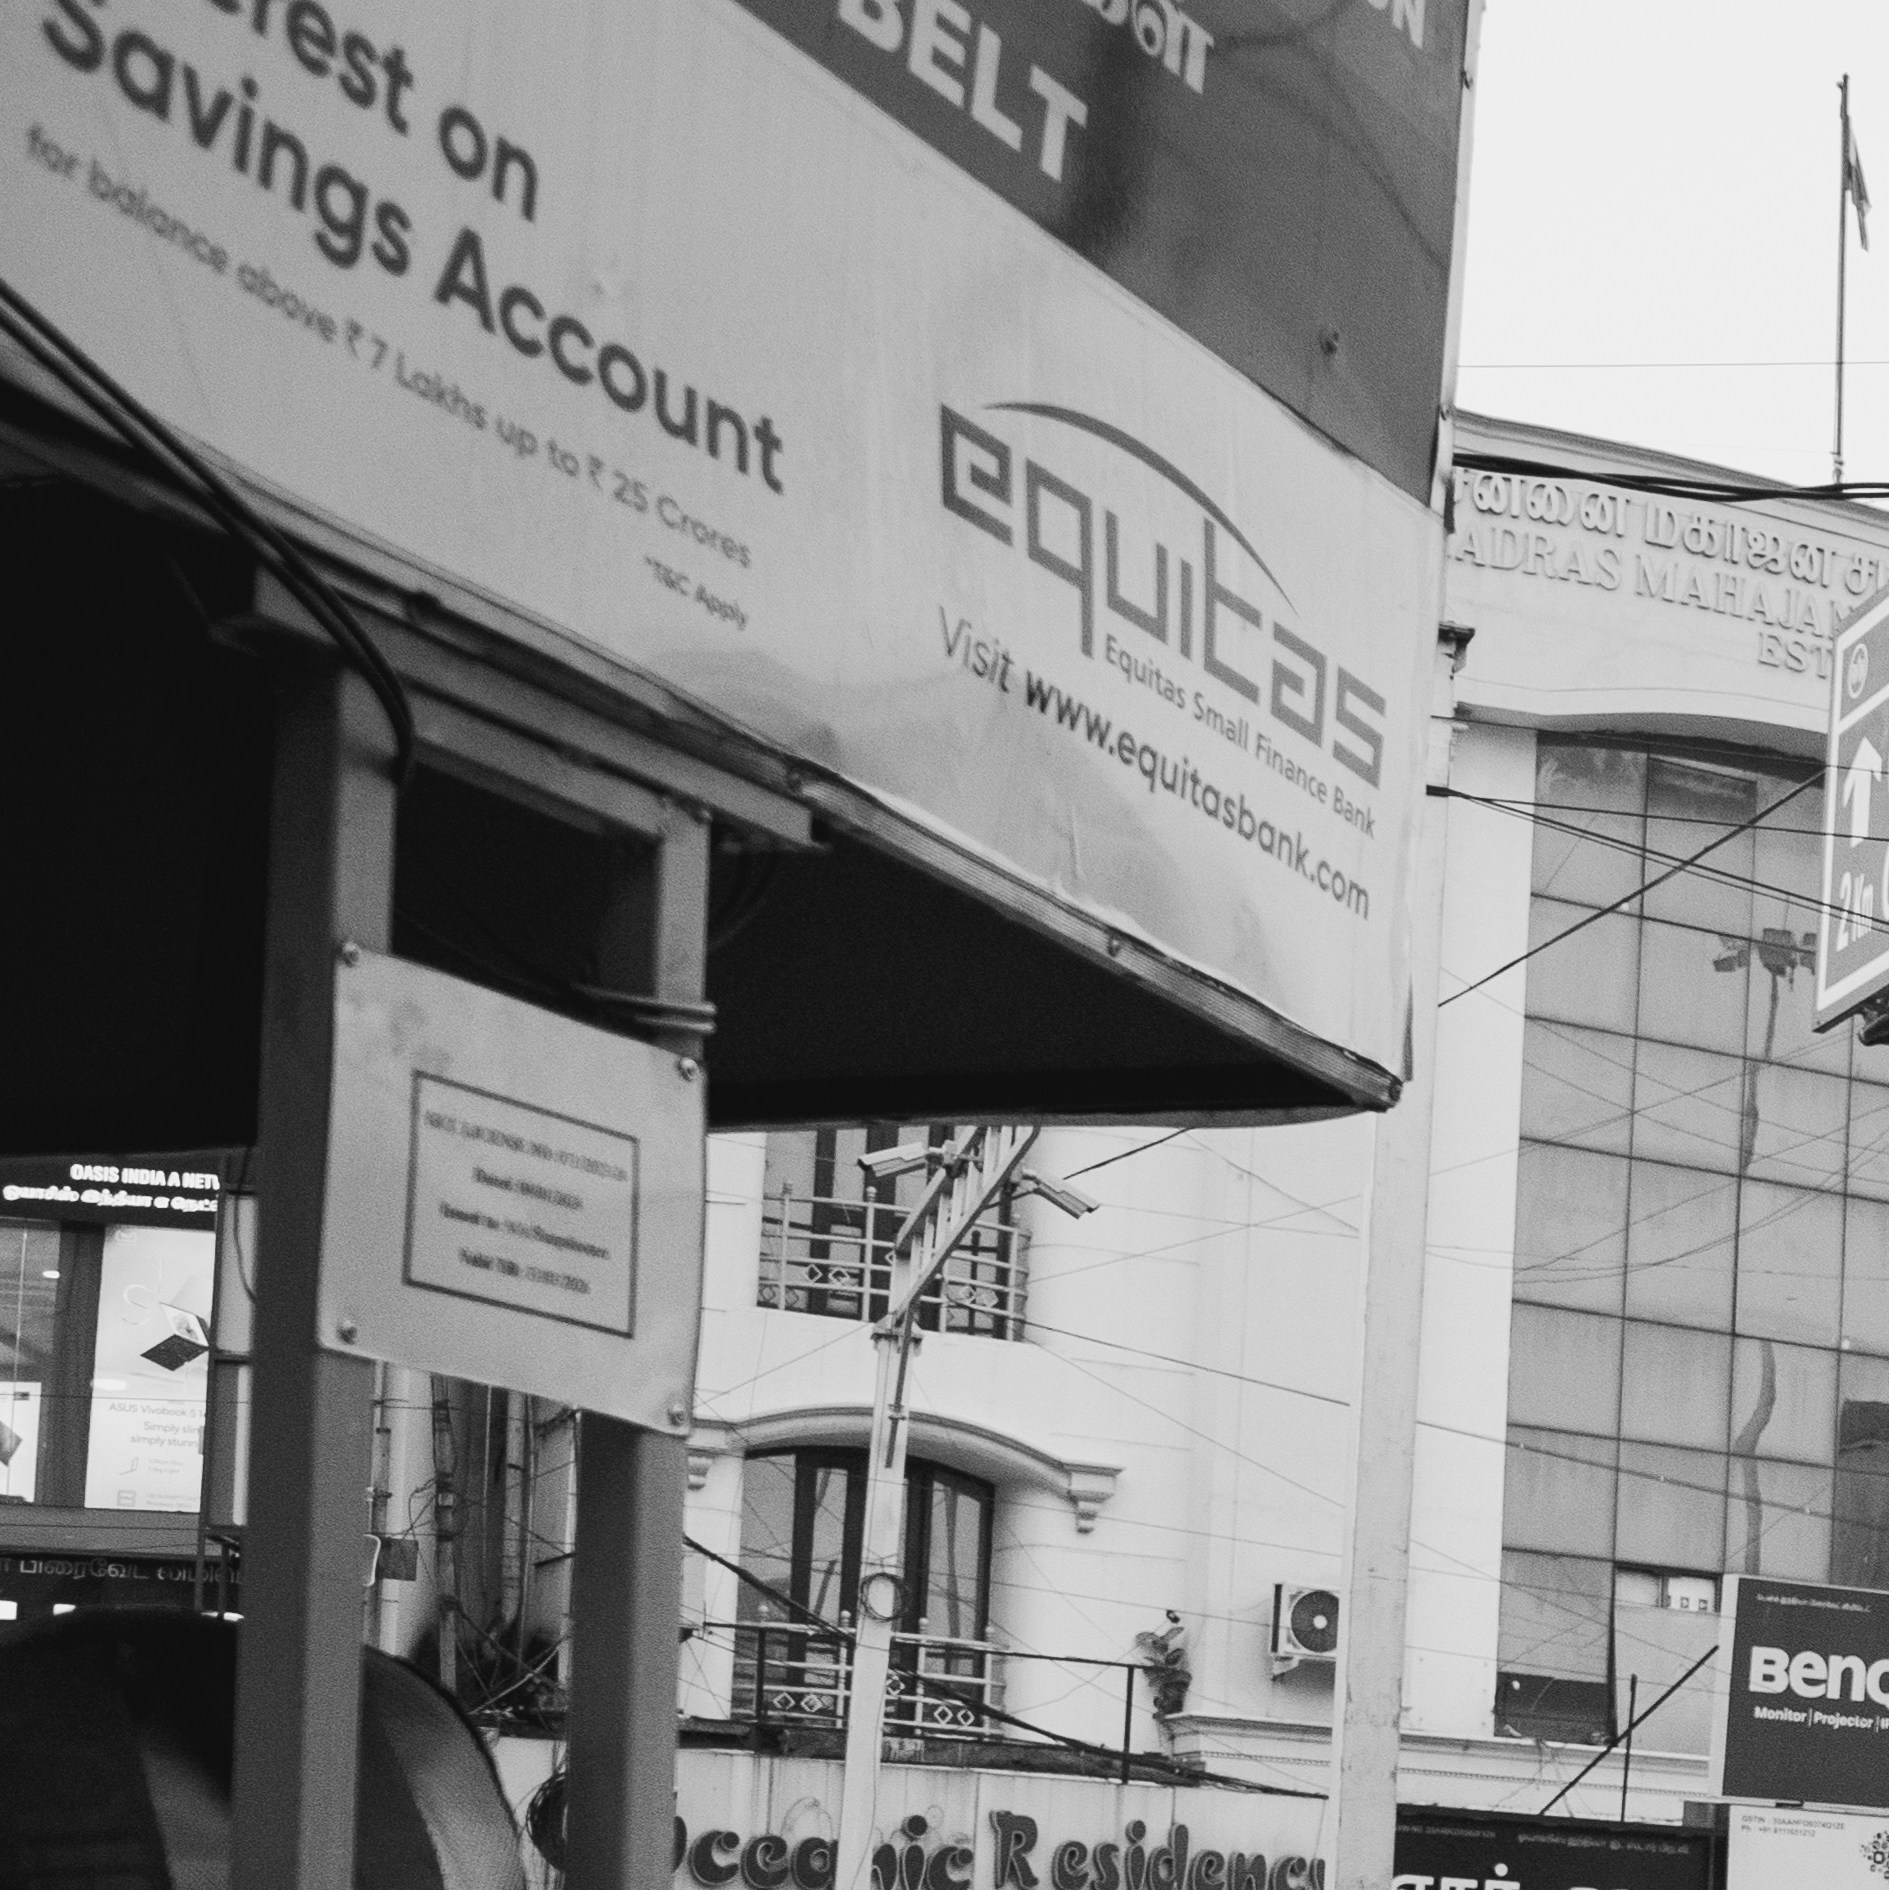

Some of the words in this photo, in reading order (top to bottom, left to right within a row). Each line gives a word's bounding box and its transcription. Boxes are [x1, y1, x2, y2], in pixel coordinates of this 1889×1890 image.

[437, 105, 540, 224] on
[41, 0, 412, 277] Savings
[433, 227, 784, 496] Account
[26, 122, 79, 178] for
[87, 158, 229, 276] balance
[236, 256, 339, 345] above
[394, 350, 488, 432] Lakhs
[496, 415, 540, 460] up
[547, 437, 581, 478] to
[613, 470, 651, 514] 25
[655, 494, 753, 570] Crores
[938, 400, 1389, 792] equitas
[938, 604, 1013, 695] Visit
[1025, 668, 1372, 922] www.equitasbank.com
[1105, 632, 1188, 712] Equitas
[1193, 690, 1250, 752] Small
[1255, 730, 1330, 806] Finance
[1332, 784, 1377, 842] Bank
[1837, 871, 1852, 952] 2
[69, 1163, 120, 1184] OASIS
[121, 1167, 167, 1187] INDIA
[167, 1170, 181, 1188] A
[109, 1402, 138, 1413] ASUS
[140, 1404, 187, 1418] Vivobook
[130, 1433, 167, 1447] simply
[143, 1421, 180, 1435] Simply
[1754, 1706, 1807, 1723] Monitor
[1813, 1711, 1874, 1731] Projector
